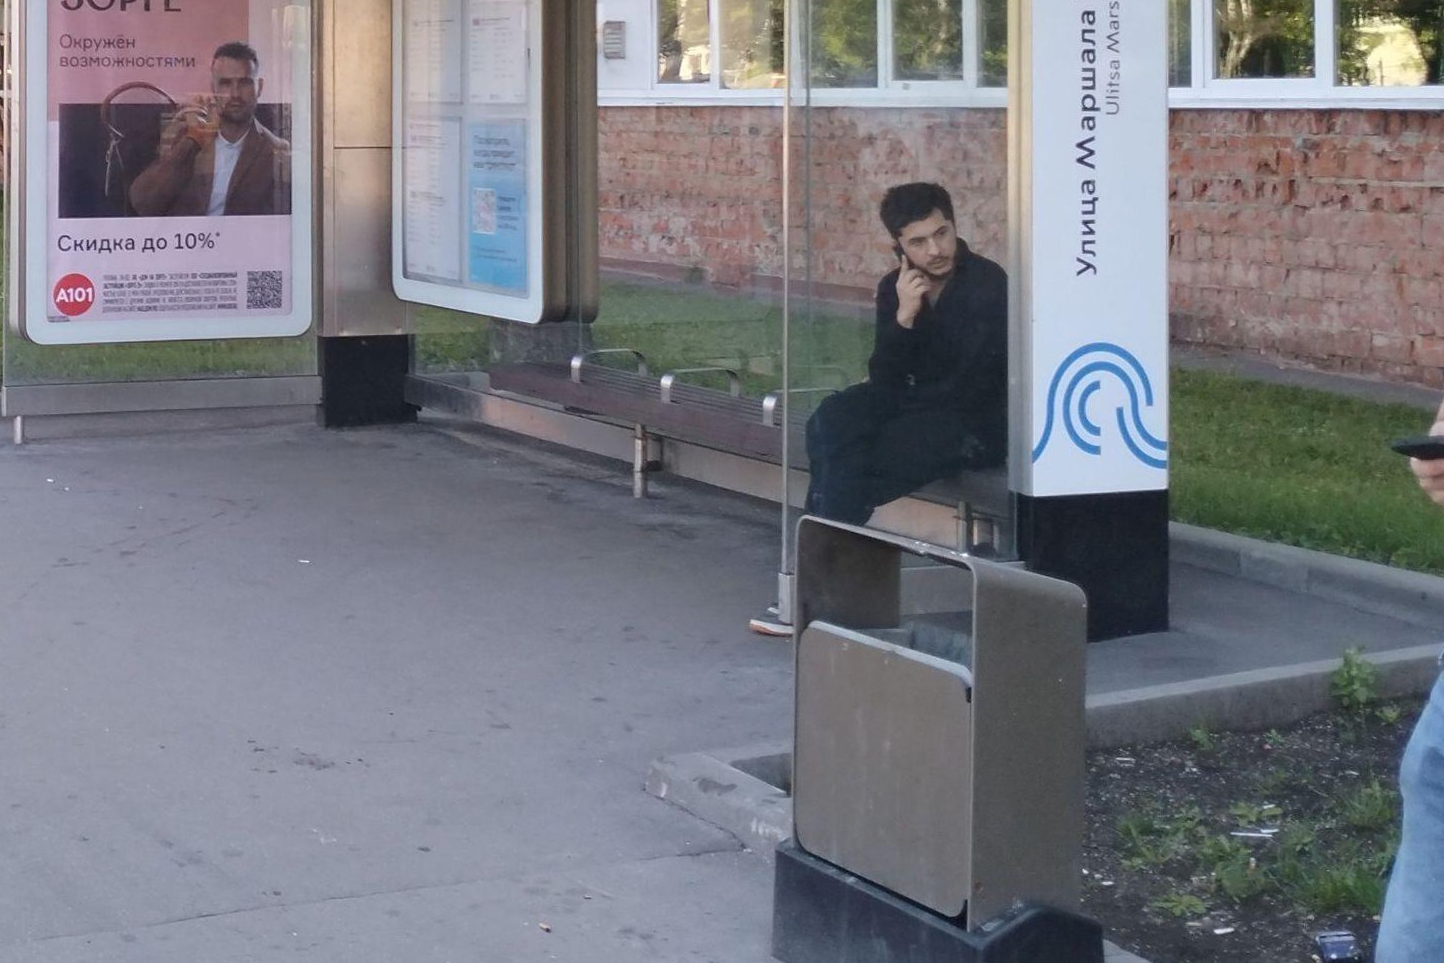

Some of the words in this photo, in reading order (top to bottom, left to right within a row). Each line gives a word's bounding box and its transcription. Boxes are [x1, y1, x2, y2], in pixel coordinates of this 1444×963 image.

[59, 33, 136, 51] Окружён
[59, 56, 196, 68] возможностями
[1075, 10, 1100, 169] Маршала
[1105, 60, 1120, 116] Ulitsa
[57, 235, 136, 254] Скидка
[142, 237, 168, 253] до
[1076, 180, 1099, 276] Улица
